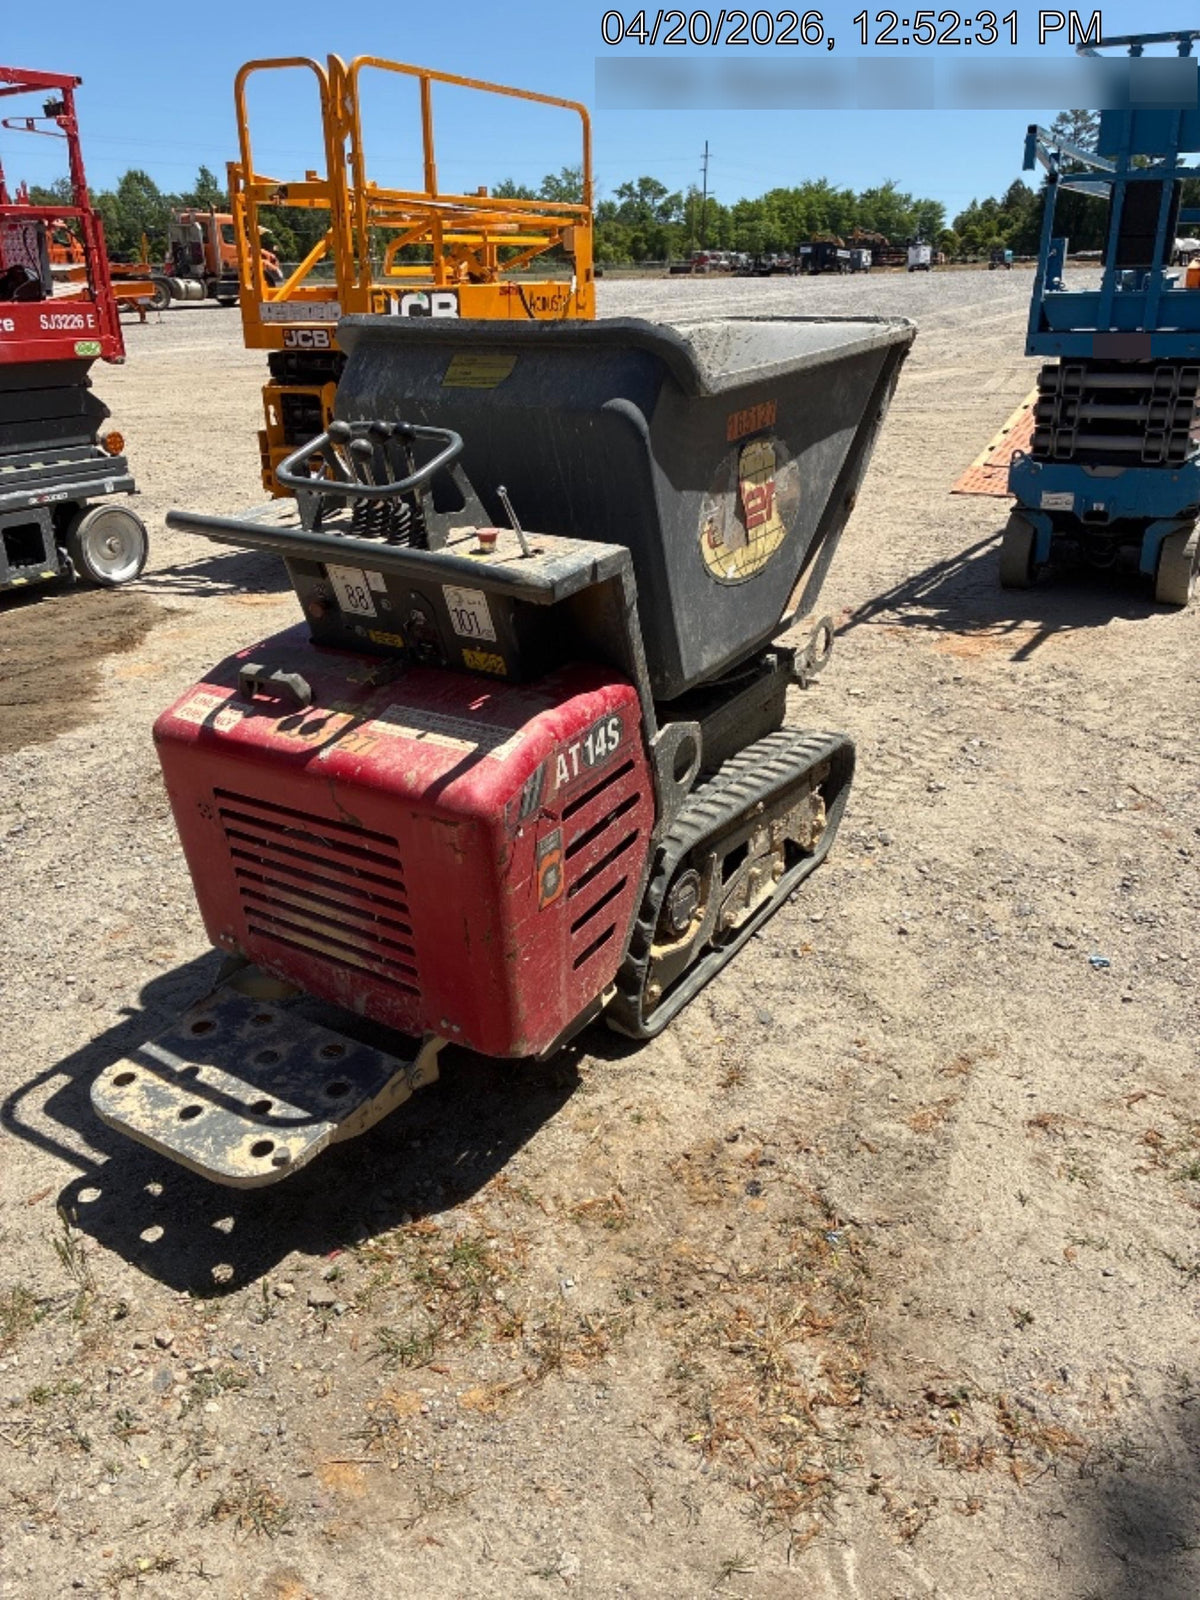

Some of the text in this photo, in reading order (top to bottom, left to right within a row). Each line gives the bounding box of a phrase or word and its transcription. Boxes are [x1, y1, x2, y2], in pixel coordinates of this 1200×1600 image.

[40, 314, 85, 330] SJ3226
[86, 314, 95, 328] E
[285, 330, 330, 348] JCB
[344, 584, 369, 610] 88
[451, 606, 482, 635] 101
[554, 717, 620, 790] AT 14S
